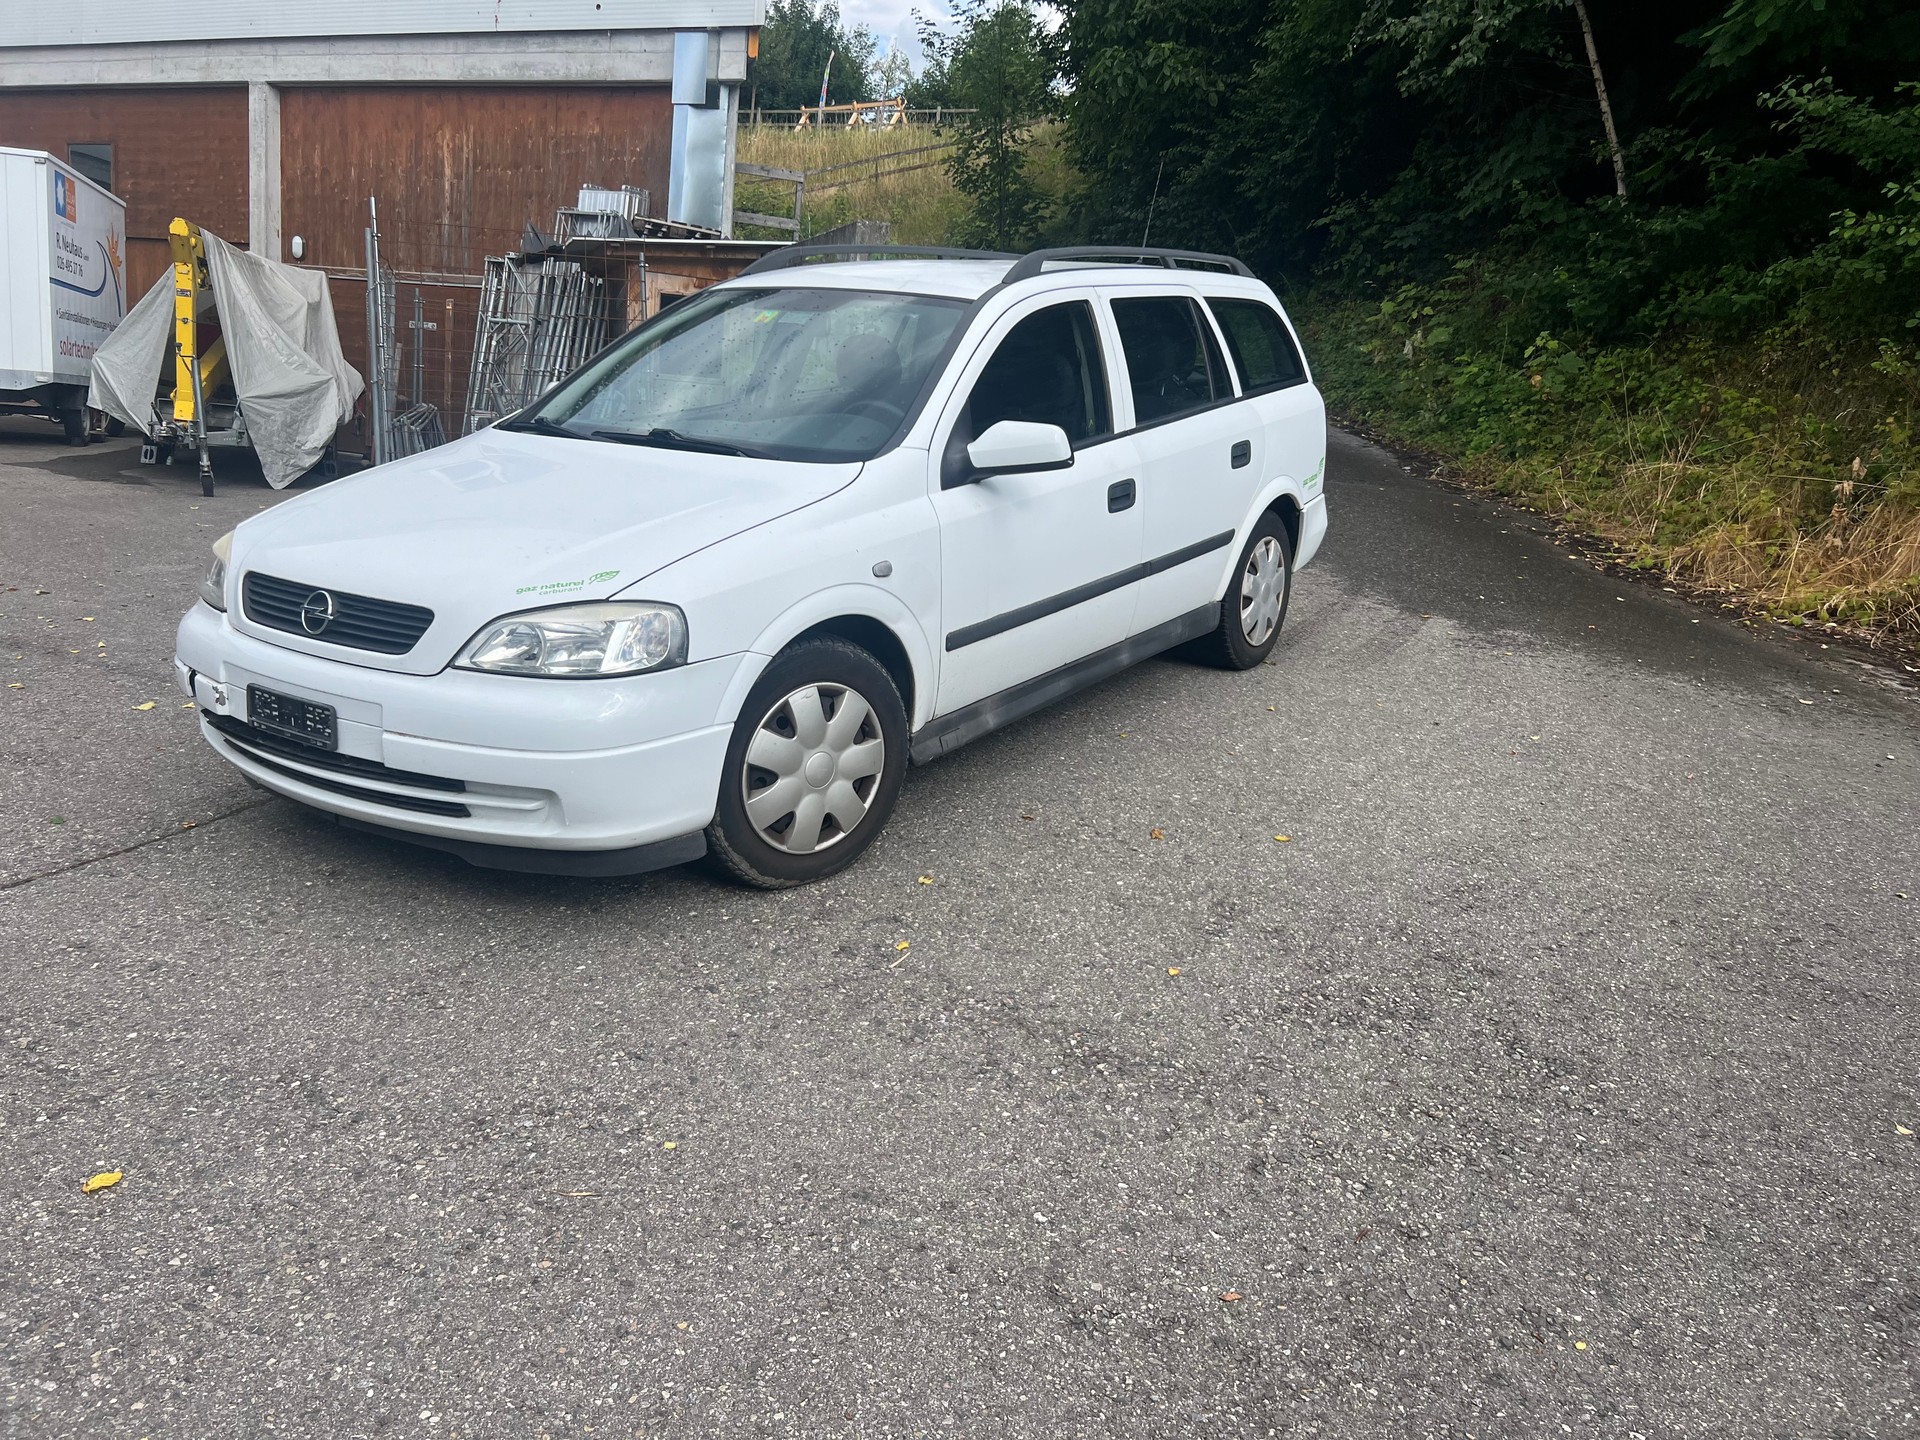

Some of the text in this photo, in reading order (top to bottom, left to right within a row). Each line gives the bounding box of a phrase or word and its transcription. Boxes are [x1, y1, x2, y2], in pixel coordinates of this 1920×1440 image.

[61, 233, 83, 259] Neuhaus
[516, 580, 584, 594] gaz naturel
[539, 586, 583, 595] carburant
